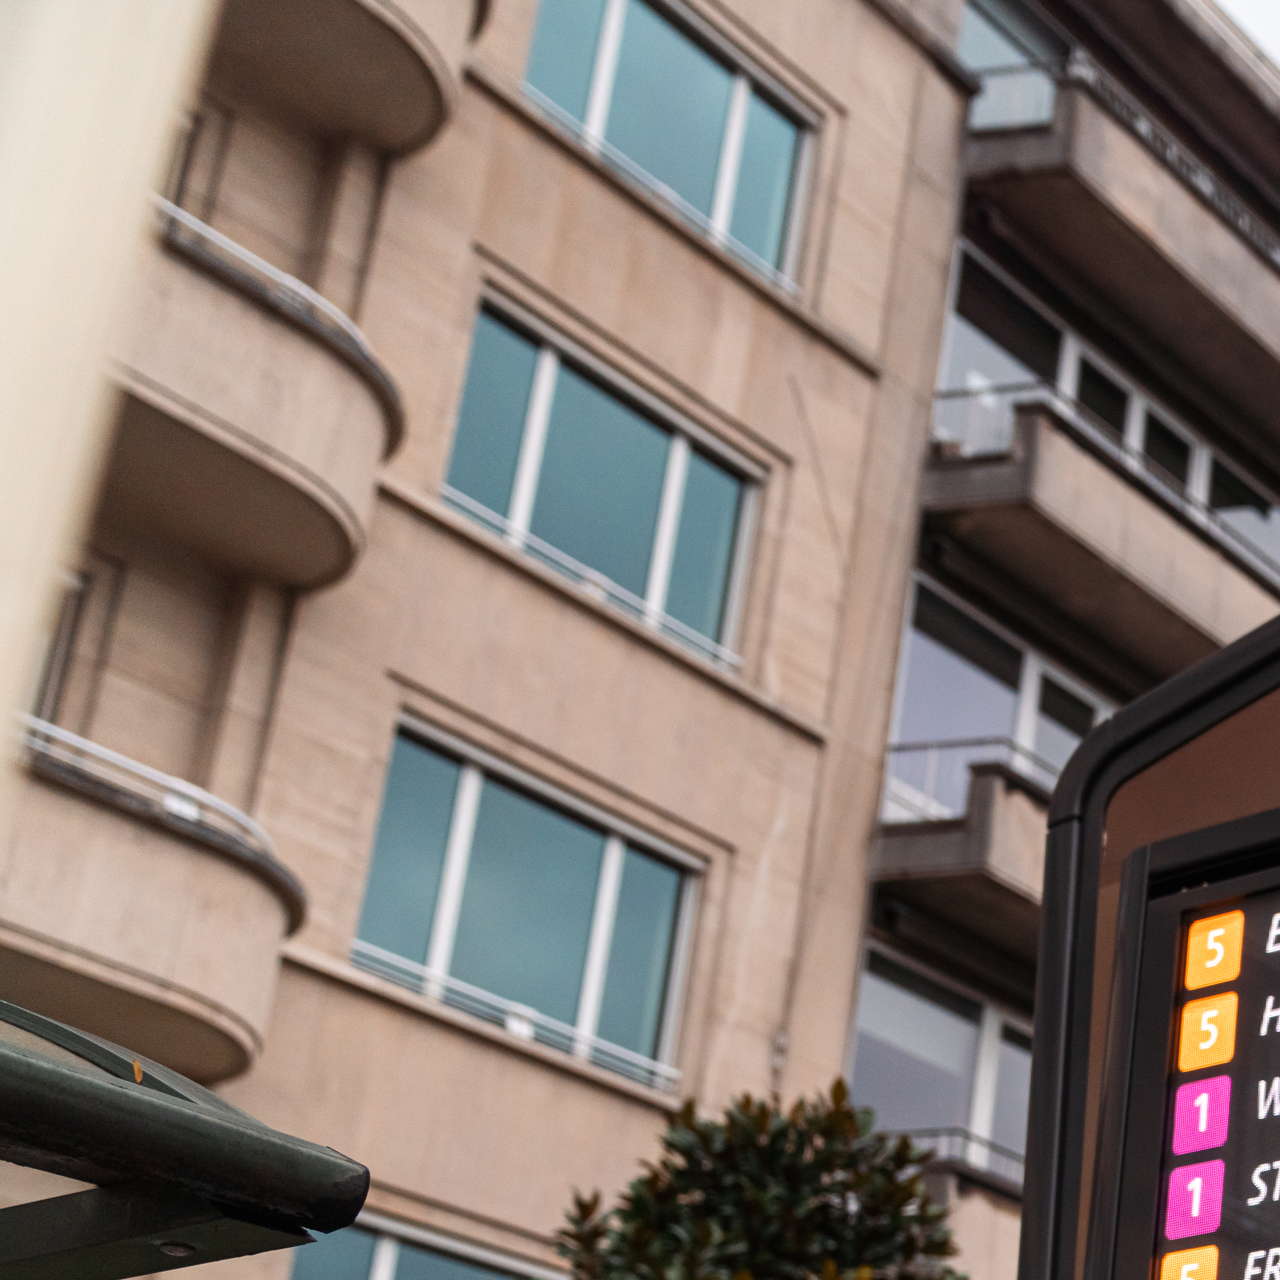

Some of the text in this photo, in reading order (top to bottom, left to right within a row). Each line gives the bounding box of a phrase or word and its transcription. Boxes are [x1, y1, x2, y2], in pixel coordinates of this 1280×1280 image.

[1205, 928, 1225, 968] 5
[1200, 1009, 1219, 1049] 5
[1194, 1093, 1209, 1132] 1
[1187, 1177, 1203, 1217] 1
